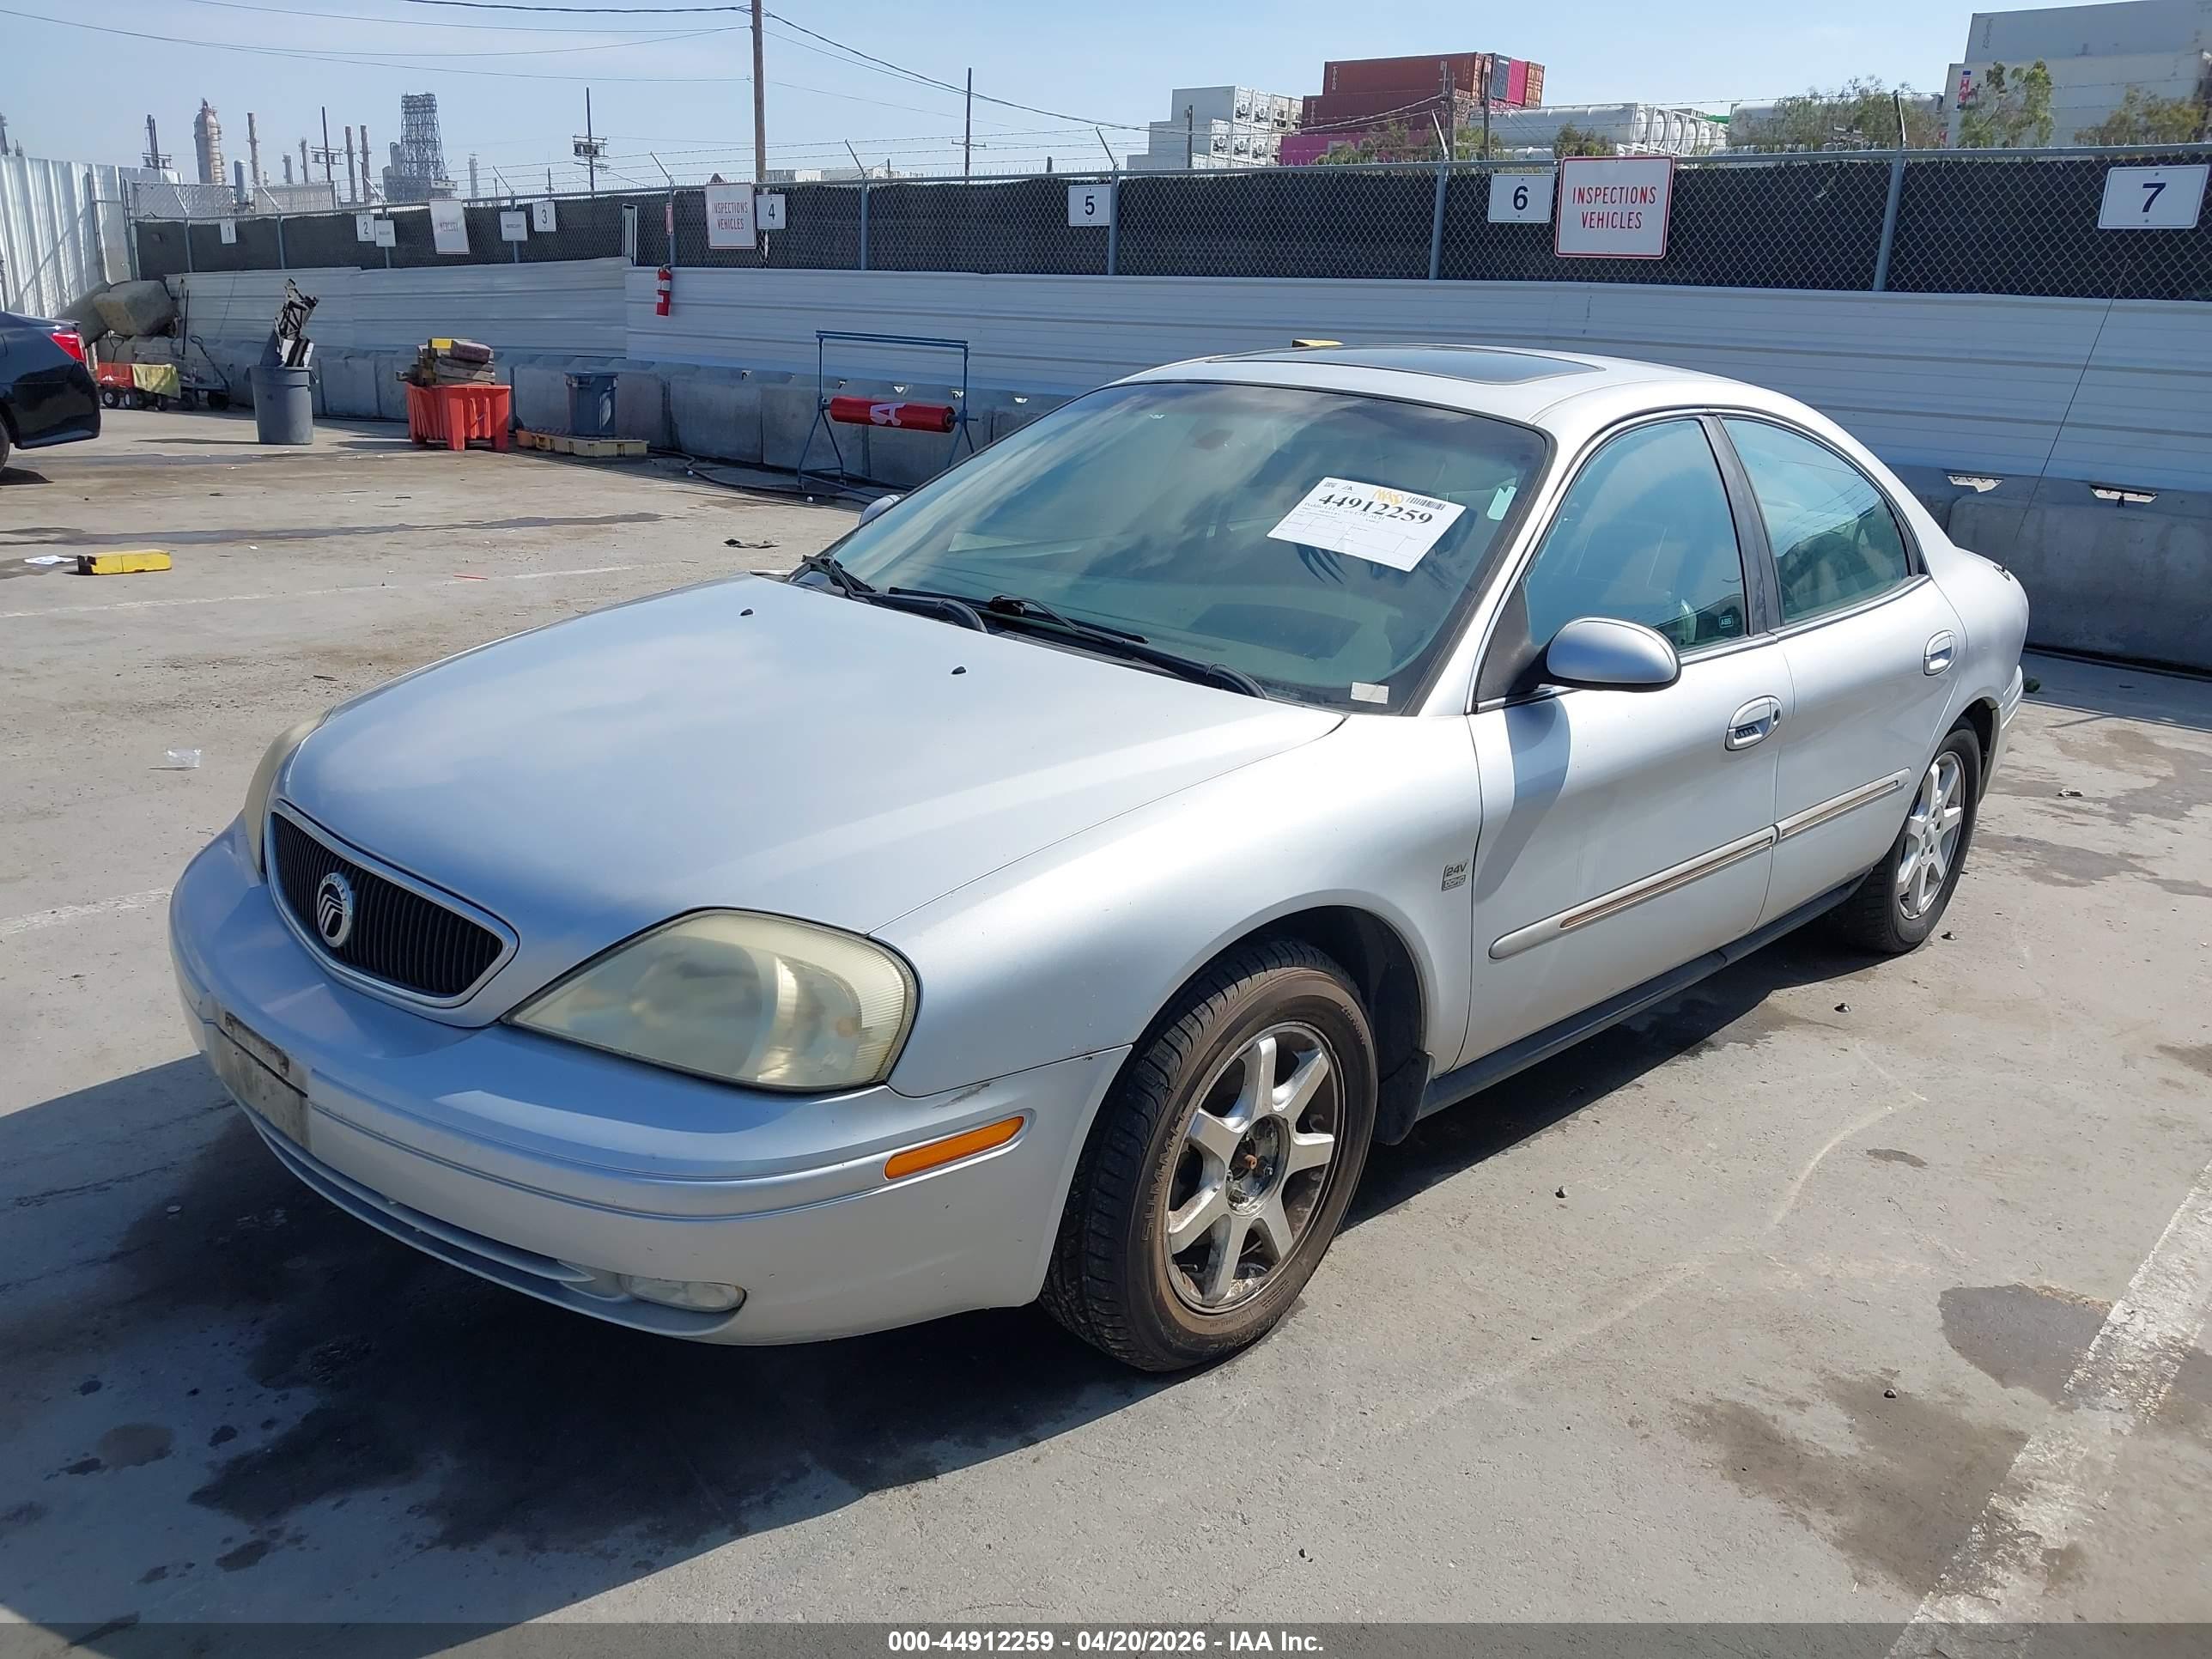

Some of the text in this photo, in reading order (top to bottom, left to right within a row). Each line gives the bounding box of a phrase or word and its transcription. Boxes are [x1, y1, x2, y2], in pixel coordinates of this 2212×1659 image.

[1512, 185, 1529, 211] 6
[1571, 185, 1657, 205] INSPECTIONS
[2142, 182, 2166, 213] 7
[711, 202, 749, 215] INSPECTIONS
[768, 203, 776, 221] 4
[1085, 195, 1096, 216] 5
[541, 209, 548, 225] 3
[716, 218, 744, 231] VEHICLES
[1581, 211, 1644, 229] VEHICLES
[362, 221, 368, 235] 2
[1318, 494, 1433, 525] 44912259
[1446, 862, 1468, 877] 24V
[1141, 1103, 1185, 1241] SUMMIT
